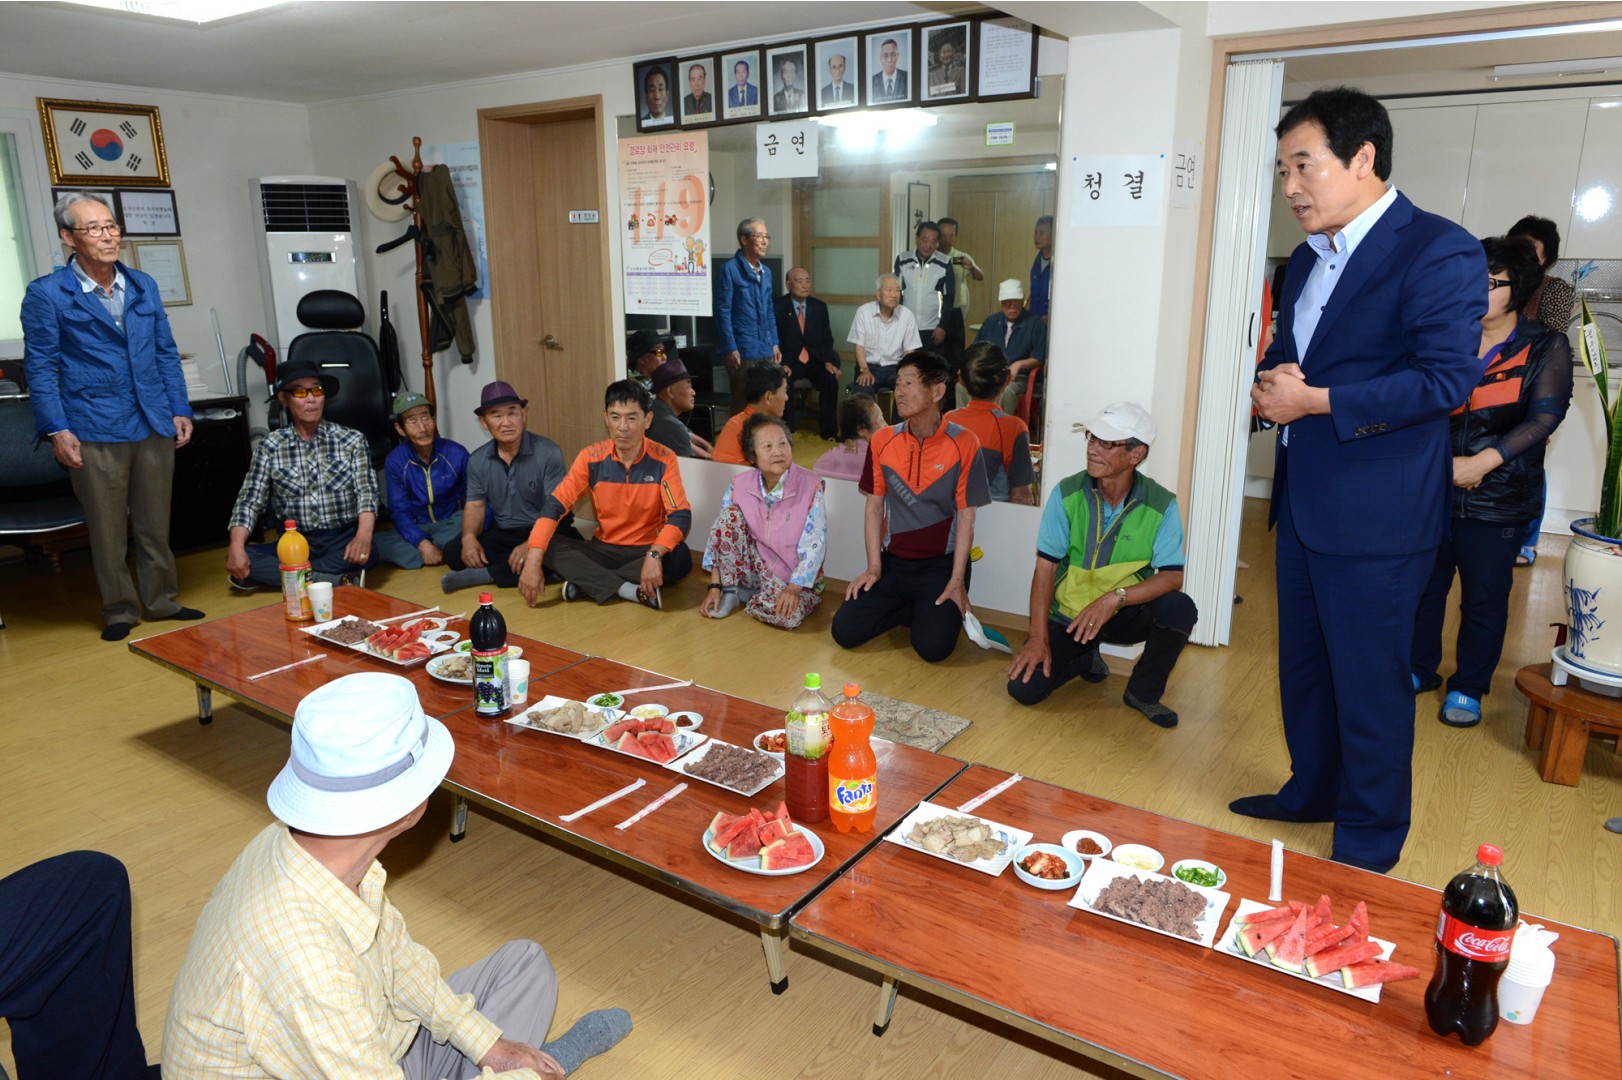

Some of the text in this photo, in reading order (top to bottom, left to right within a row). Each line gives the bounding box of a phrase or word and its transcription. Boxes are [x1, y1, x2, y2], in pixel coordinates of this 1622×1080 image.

[1175, 153, 1196, 189] 금연
[633, 174, 706, 246] 119
[889, 474, 917, 506] MILLET
[836, 783, 872, 805] Fanta
[1459, 932, 1511, 952] Coca-Cola
